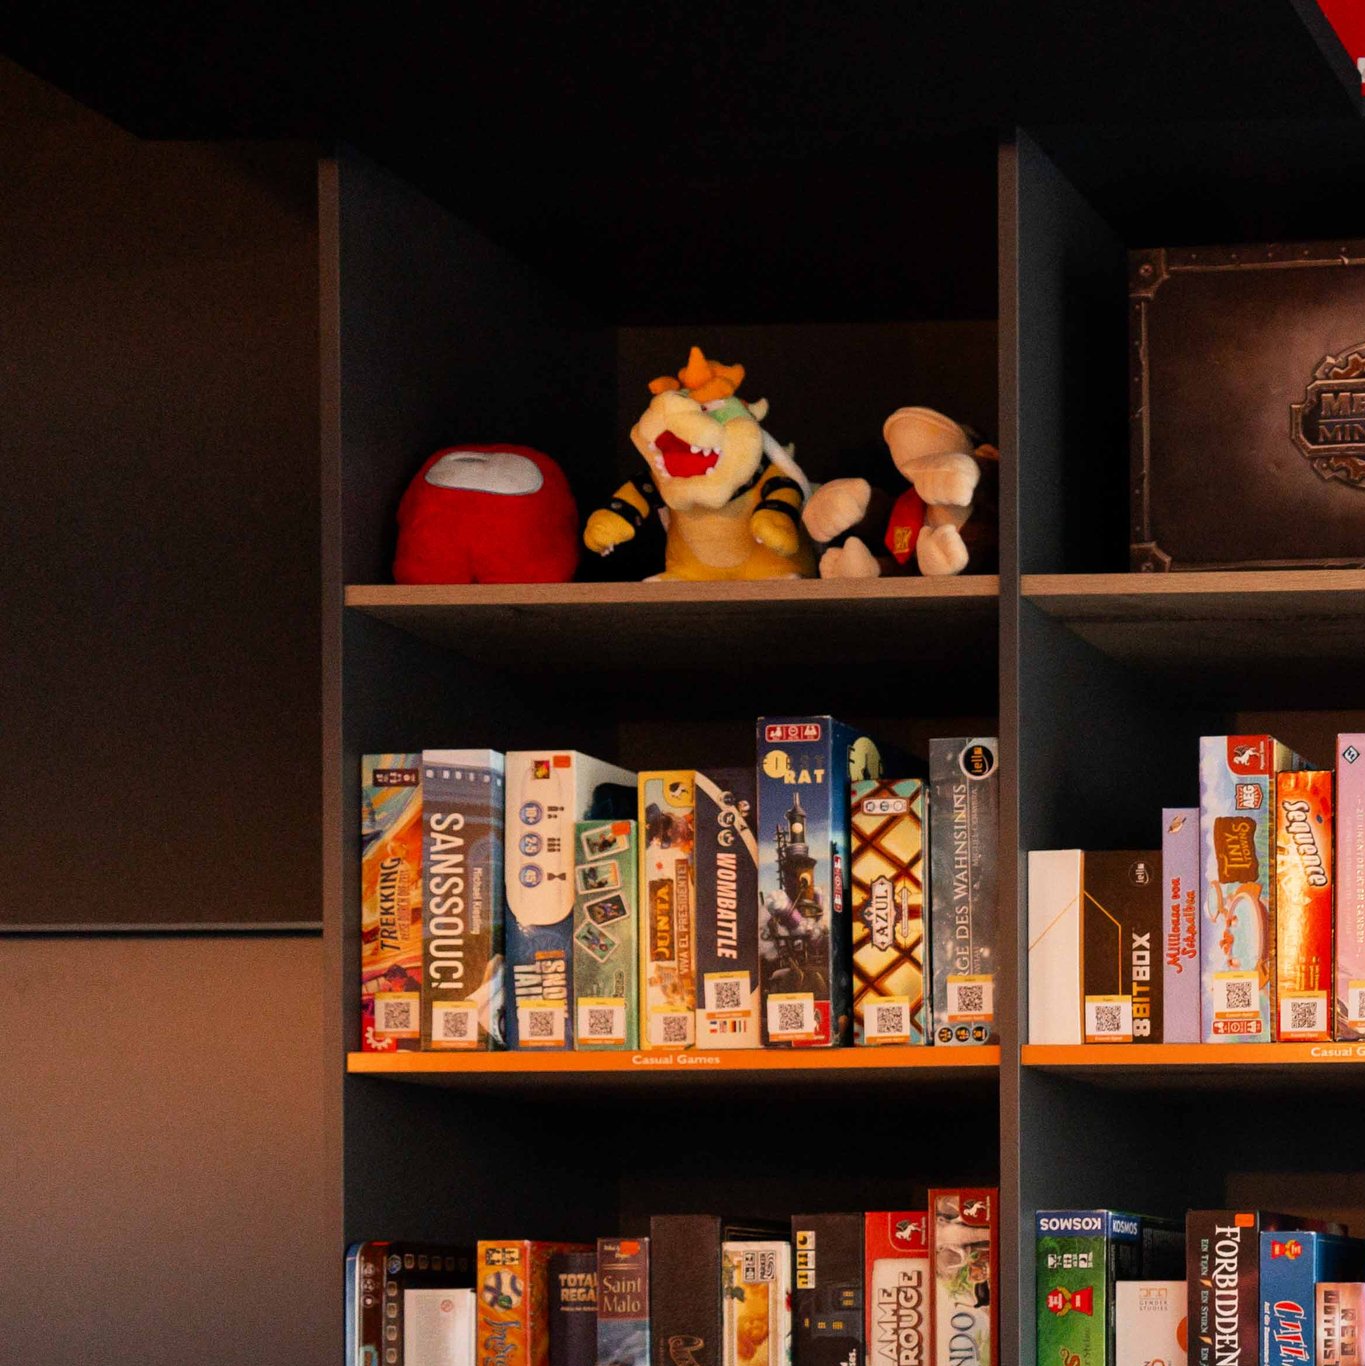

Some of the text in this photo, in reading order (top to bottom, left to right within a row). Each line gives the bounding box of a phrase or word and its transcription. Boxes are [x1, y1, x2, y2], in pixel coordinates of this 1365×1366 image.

[1283, 800, 1327, 886] Sequence
[381, 857, 401, 951] TREKKING
[717, 853, 737, 959] WOMBATTLE
[875, 891, 889, 936] AZUL
[1132, 931, 1150, 1037] 8BITBOX
[632, 1054, 720, 1066] Casual Games
[1311, 1047, 1353, 1057] Casual
[1040, 1218, 1101, 1230] KOSMOS
[1113, 1215, 1137, 1235] KOSMOS
[603, 1277, 641, 1294] Saint
[603, 1294, 641, 1313] Malo
